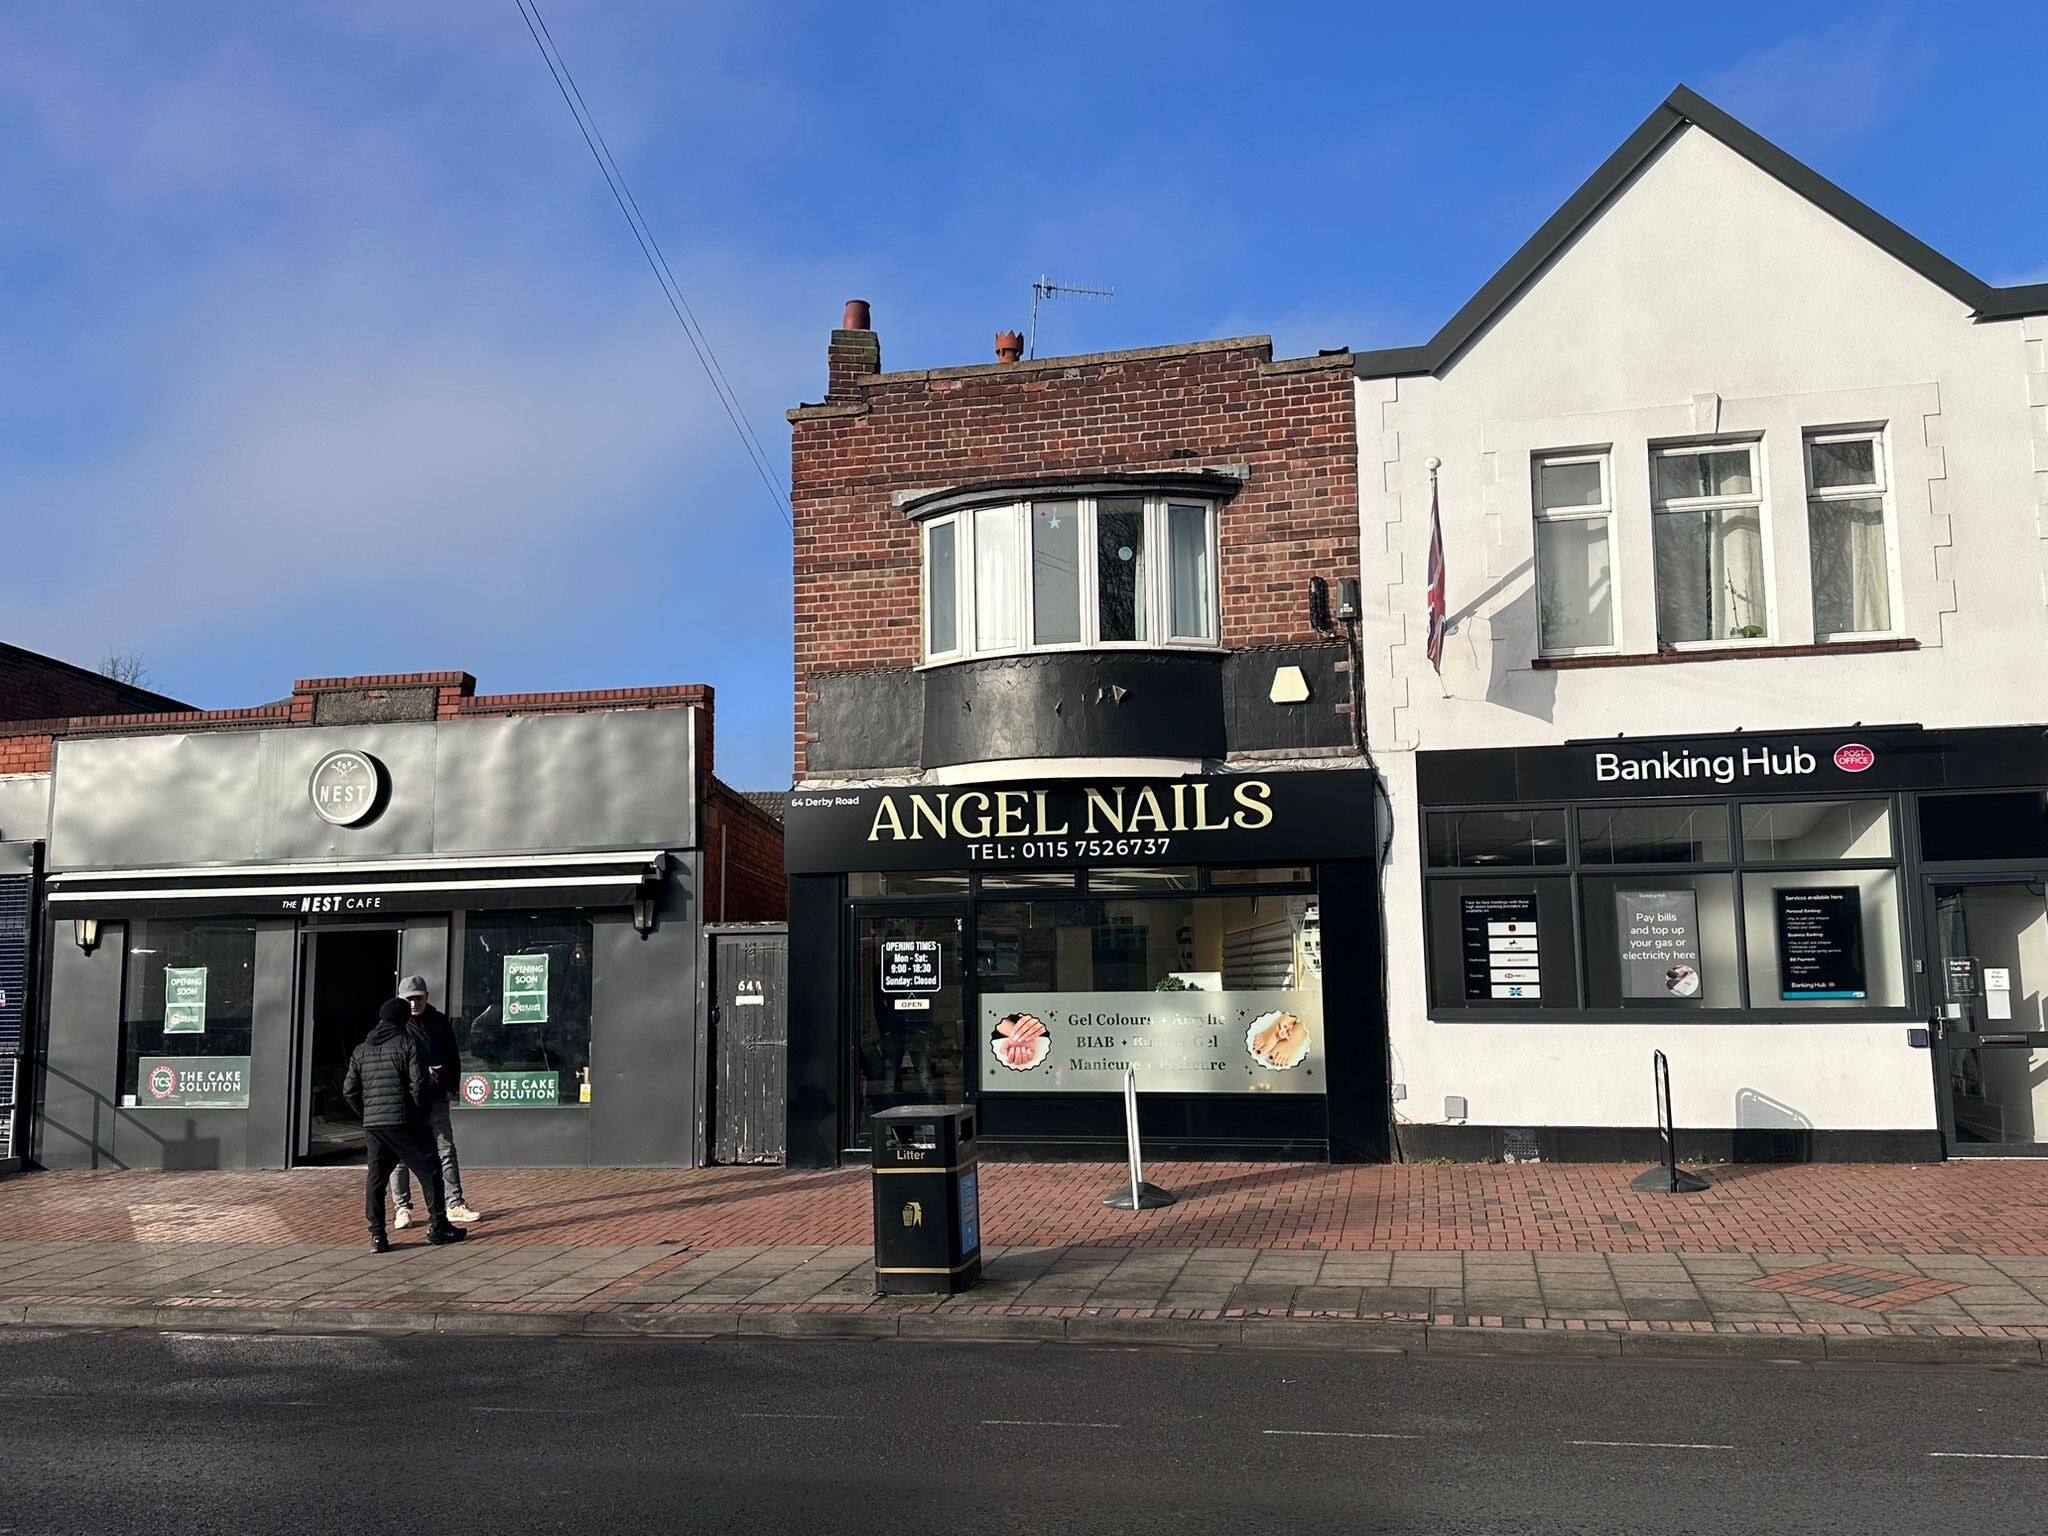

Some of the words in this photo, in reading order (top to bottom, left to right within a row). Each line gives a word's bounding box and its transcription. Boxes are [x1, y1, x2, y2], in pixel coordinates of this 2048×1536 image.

[1843, 749, 1865, 757] POST
[1595, 750, 1735, 784] Banking
[1741, 745, 1817, 776] Hub
[1839, 756, 1869, 765] OFFICE
[320, 785, 366, 803] NEST
[791, 798, 804, 807] 64
[805, 797, 833, 808] Derby
[835, 796, 860, 806] Road
[867, 789, 1069, 842] ANGEL
[1084, 780, 1274, 833] NAILS
[966, 843, 1016, 860] TEL:
[1022, 841, 1069, 859] 0115
[1074, 838, 1171, 858] 7526737
[282, 900, 298, 909] THE
[300, 896, 342, 912] NEST
[345, 897, 381, 909] CAFE
[1636, 912, 1655, 923] Pay
[1657, 912, 1678, 922] bills
[1630, 926, 1649, 935] and
[1651, 926, 1669, 936] top
[1671, 927, 1686, 936] up
[885, 941, 915, 952] OPENING
[916, 941, 937, 951] TIMES
[1629, 940, 1652, 949] your
[1654, 940, 1673, 949] gas
[1675, 939, 1687, 947] or
[894, 953, 909, 963] Mon
[914, 953, 929, 962] Sat:
[1622, 951, 1671, 961] electricity
[1673, 951, 1696, 960] here
[508, 964, 544, 974] OPENING
[891, 963, 907, 974] 9:00
[912, 963, 932, 973] 18:30
[171, 977, 203, 986] OPENING
[515, 975, 539, 984] SOON
[885, 976, 913, 988] Sunday:
[914, 975, 937, 985] Closed
[176, 987, 198, 996] SOON
[1068, 1013, 1092, 1026] Gel
[1096, 1013, 1154, 1026] Colours
[1076, 1036, 1115, 1049] BIAB
[1069, 1057, 1141, 1071] Manicure
[1159, 1058, 1227, 1071] Pcure
[153, 1076, 171, 1088] TCS
[180, 1071, 203, 1082] THE
[207, 1071, 241, 1082] CAKE
[179, 1081, 241, 1092] SOLUTION
[493, 1079, 517, 1090] THE
[521, 1079, 555, 1089] CAKE
[468, 1086, 484, 1095] TCS
[493, 1089, 555, 1100] SOLUTION
[896, 1150, 926, 1160] Litter
